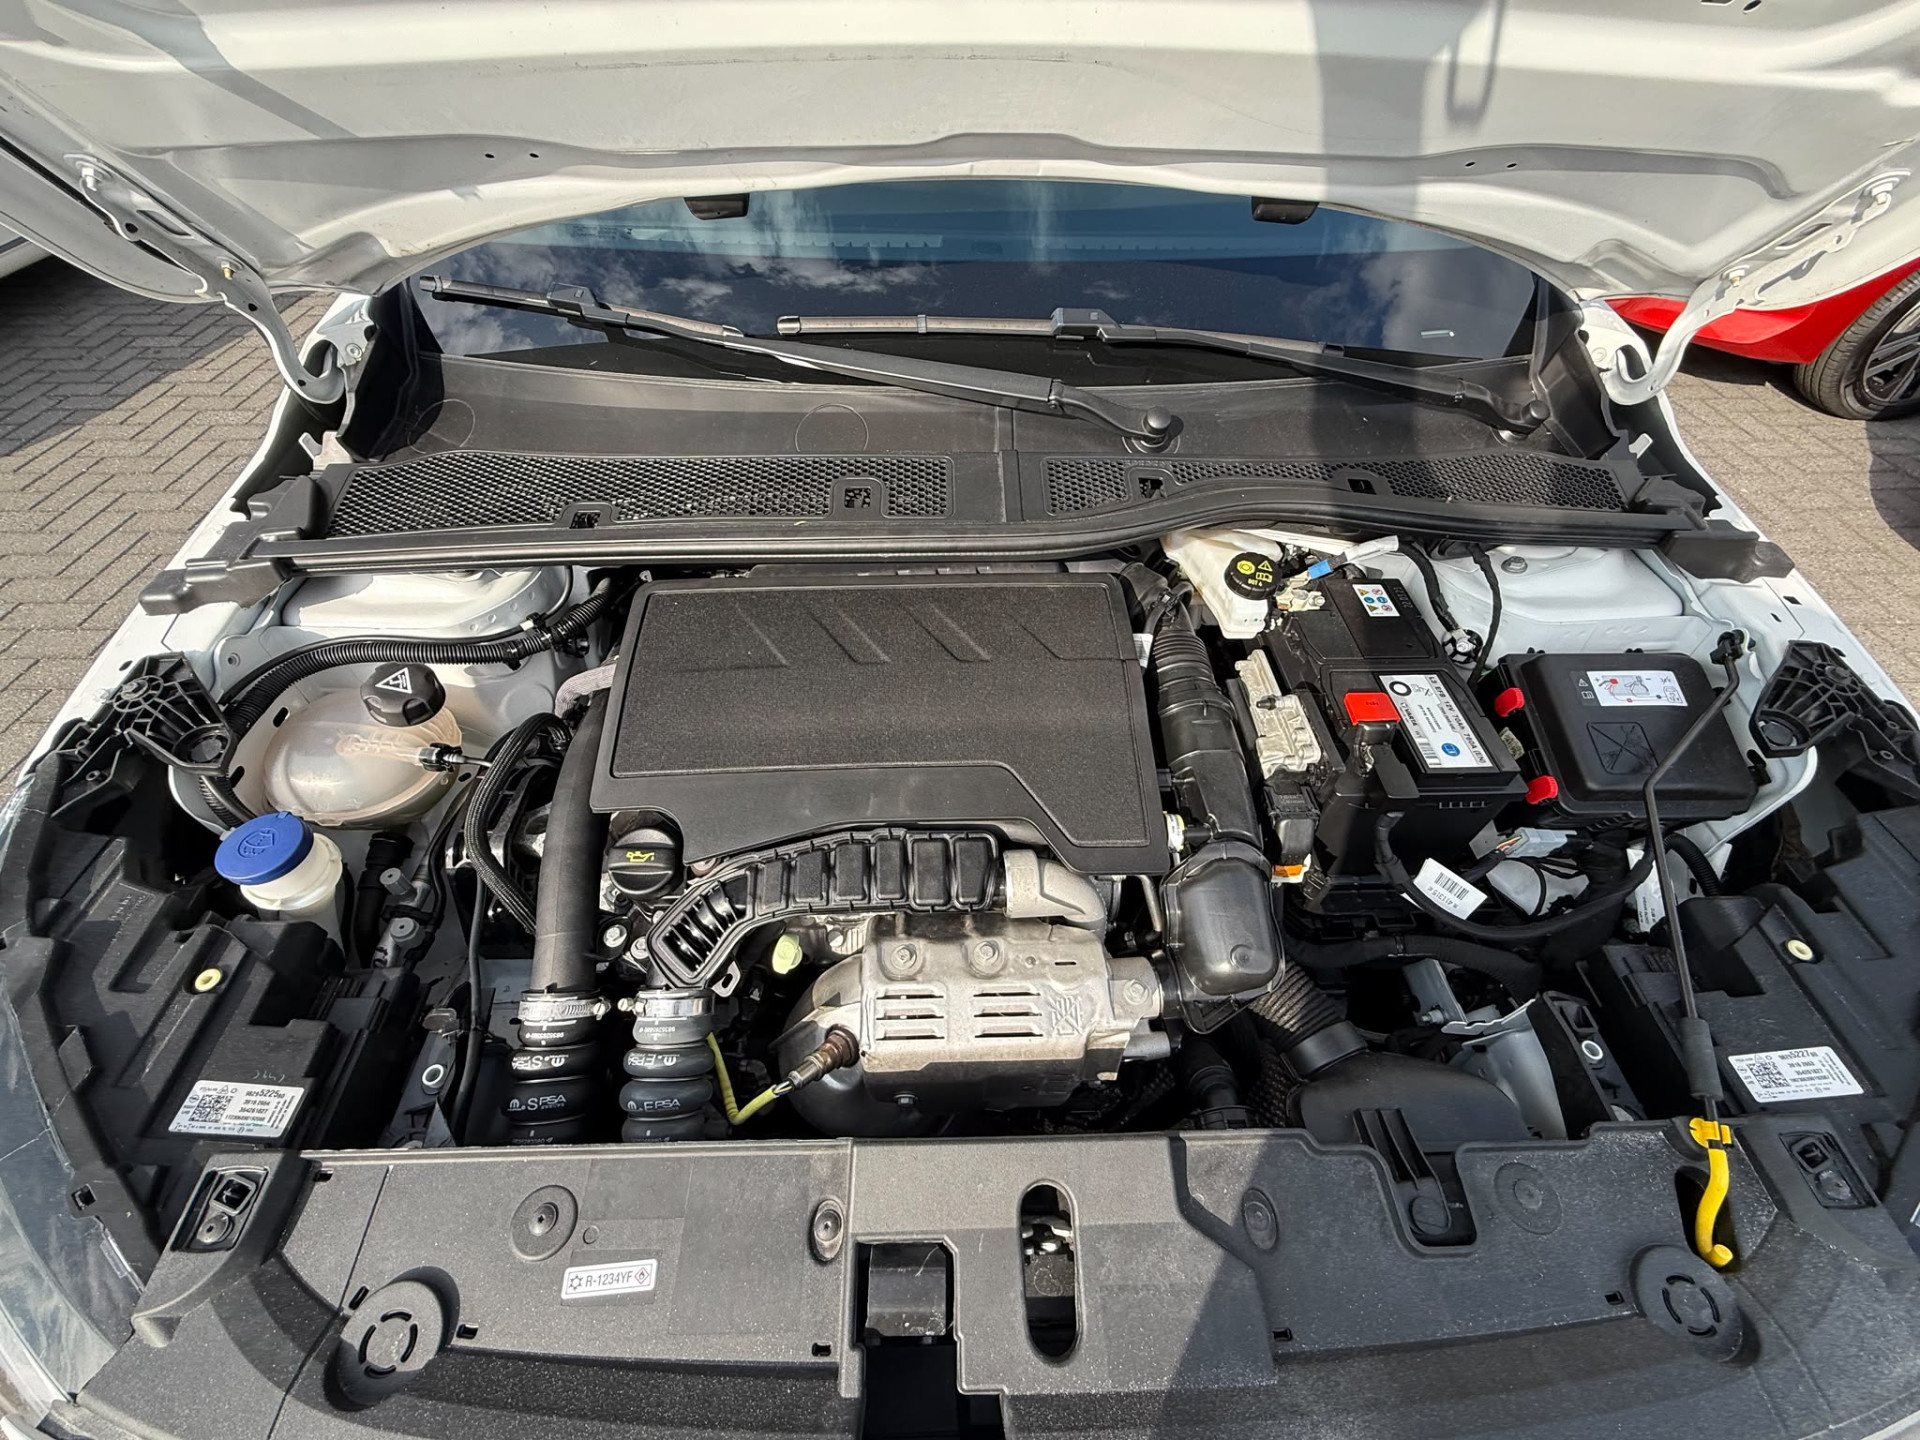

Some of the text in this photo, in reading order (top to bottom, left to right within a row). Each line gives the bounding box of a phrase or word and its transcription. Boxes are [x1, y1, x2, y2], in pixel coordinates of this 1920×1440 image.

[1404, 708, 1418, 726] VARTA
[1429, 676, 1438, 684] L3
[1435, 686, 1446, 698] EFB
[1444, 701, 1455, 712] 12V
[1452, 714, 1465, 730] 70Ah
[1473, 748, 1486, 764] (EN)
[512, 1060, 531, 1070] PSA
[539, 1094, 566, 1106] PSA
[655, 1099, 681, 1109] PSA
[585, 1270, 633, 1287] R-1234YF
